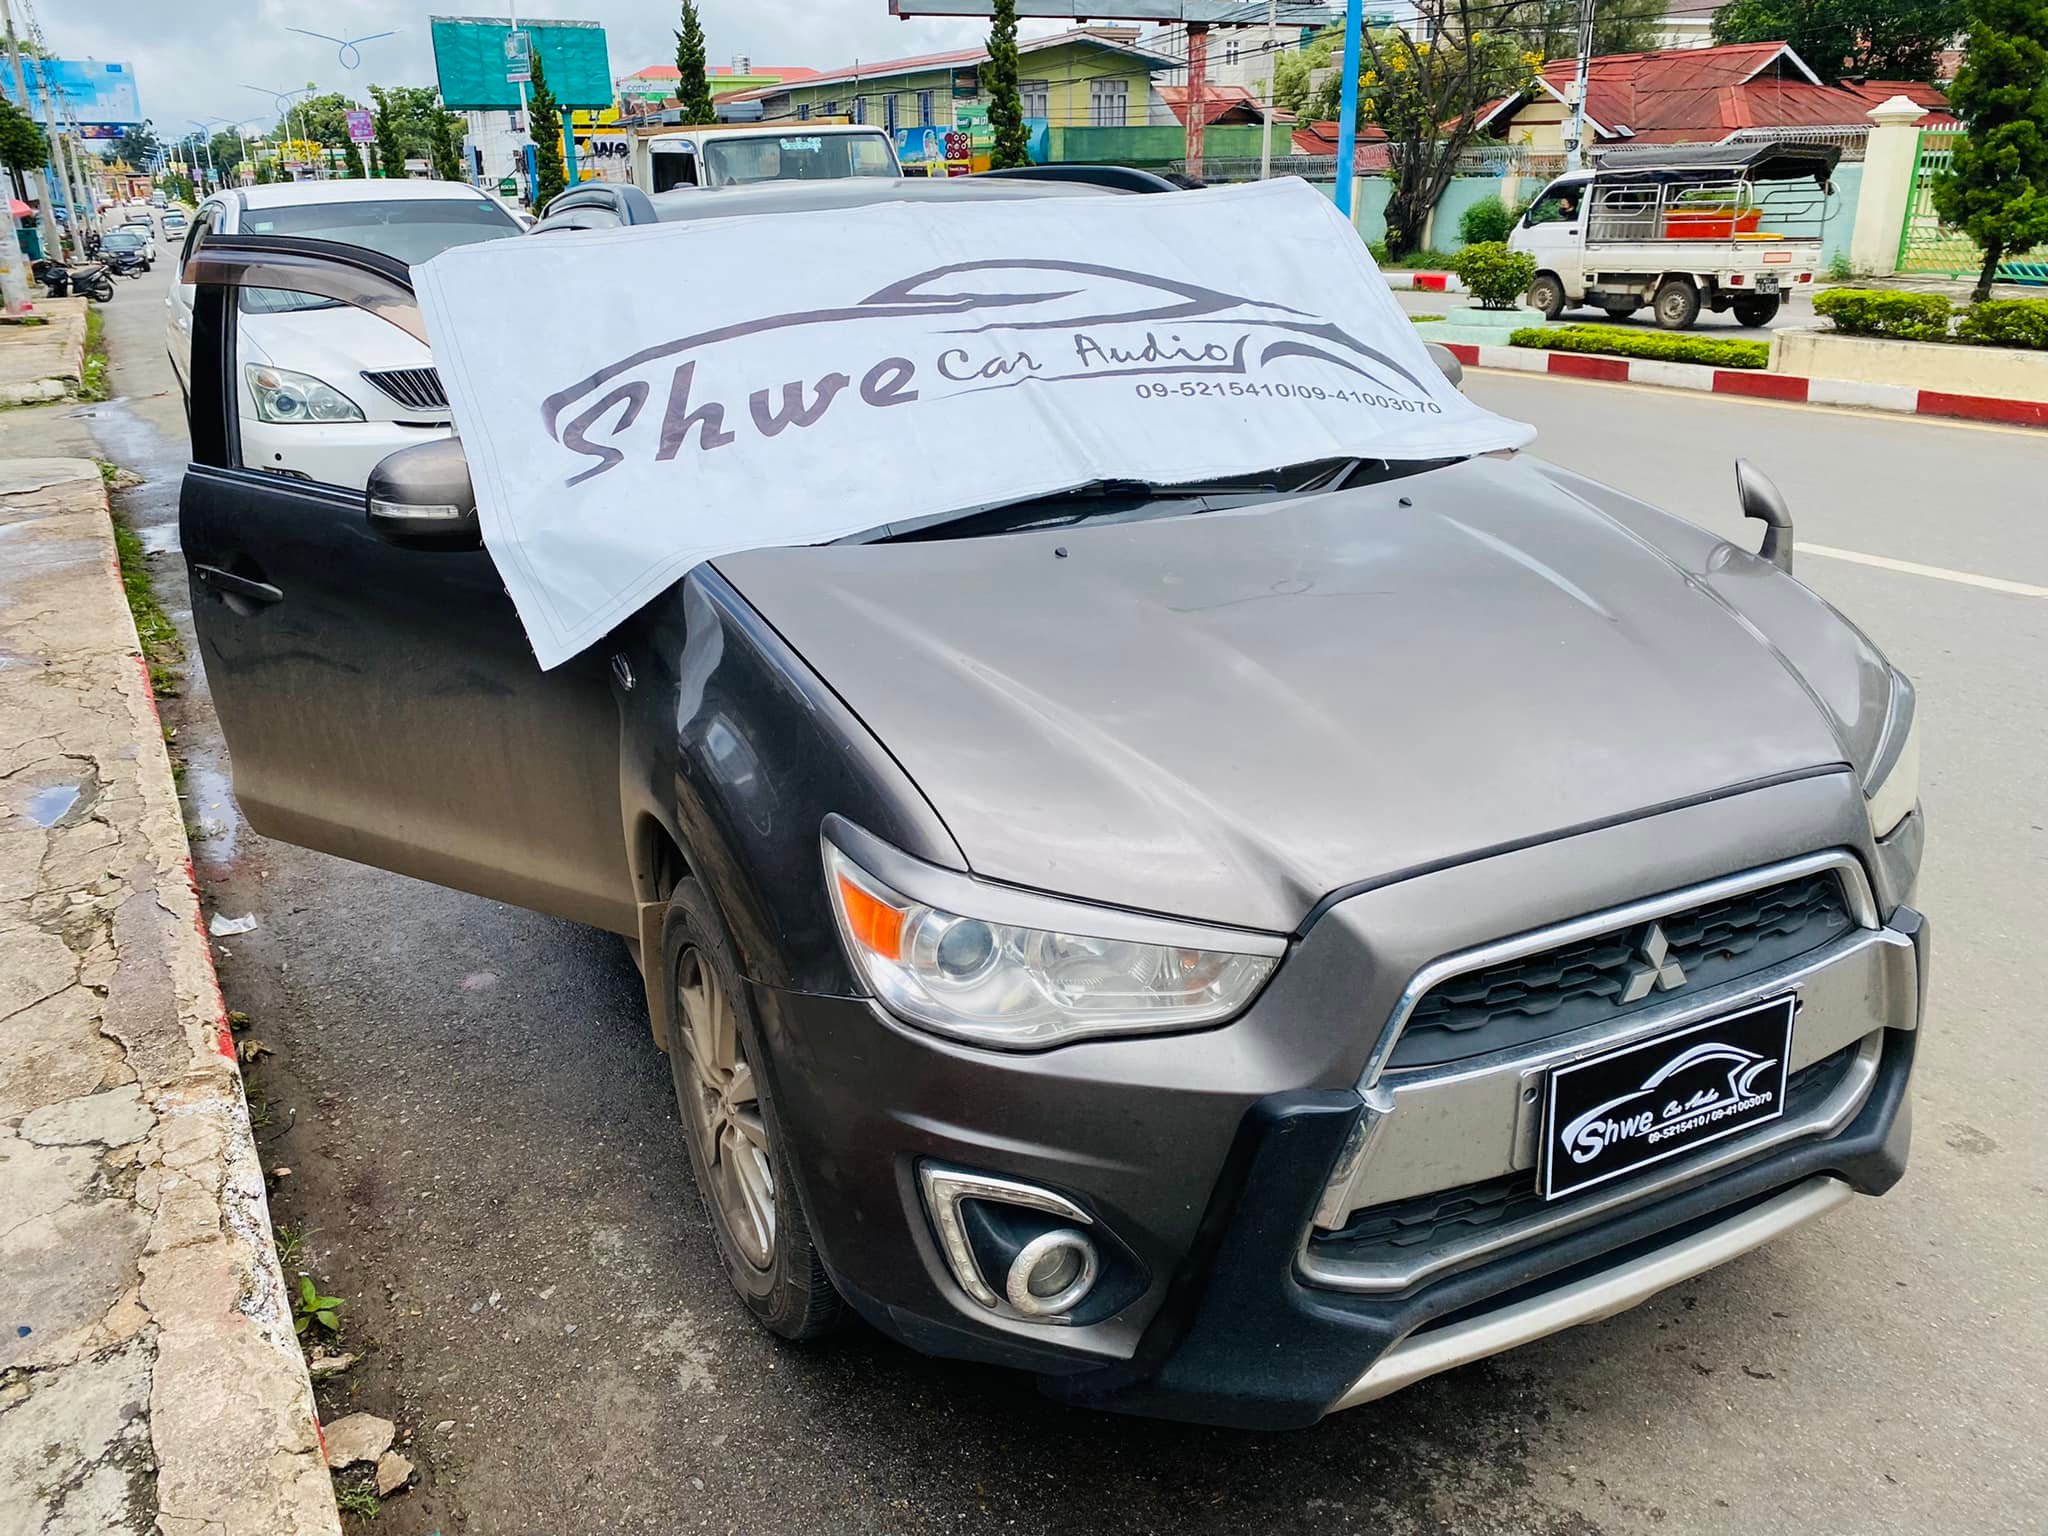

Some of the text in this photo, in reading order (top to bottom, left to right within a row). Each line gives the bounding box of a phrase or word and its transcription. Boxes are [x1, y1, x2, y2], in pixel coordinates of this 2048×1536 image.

[562, 332, 1228, 489] Shwe Car Audio
[1135, 381, 1443, 415] 09-5215410/09-41003070
[1572, 1111, 1654, 1164] Shwe
